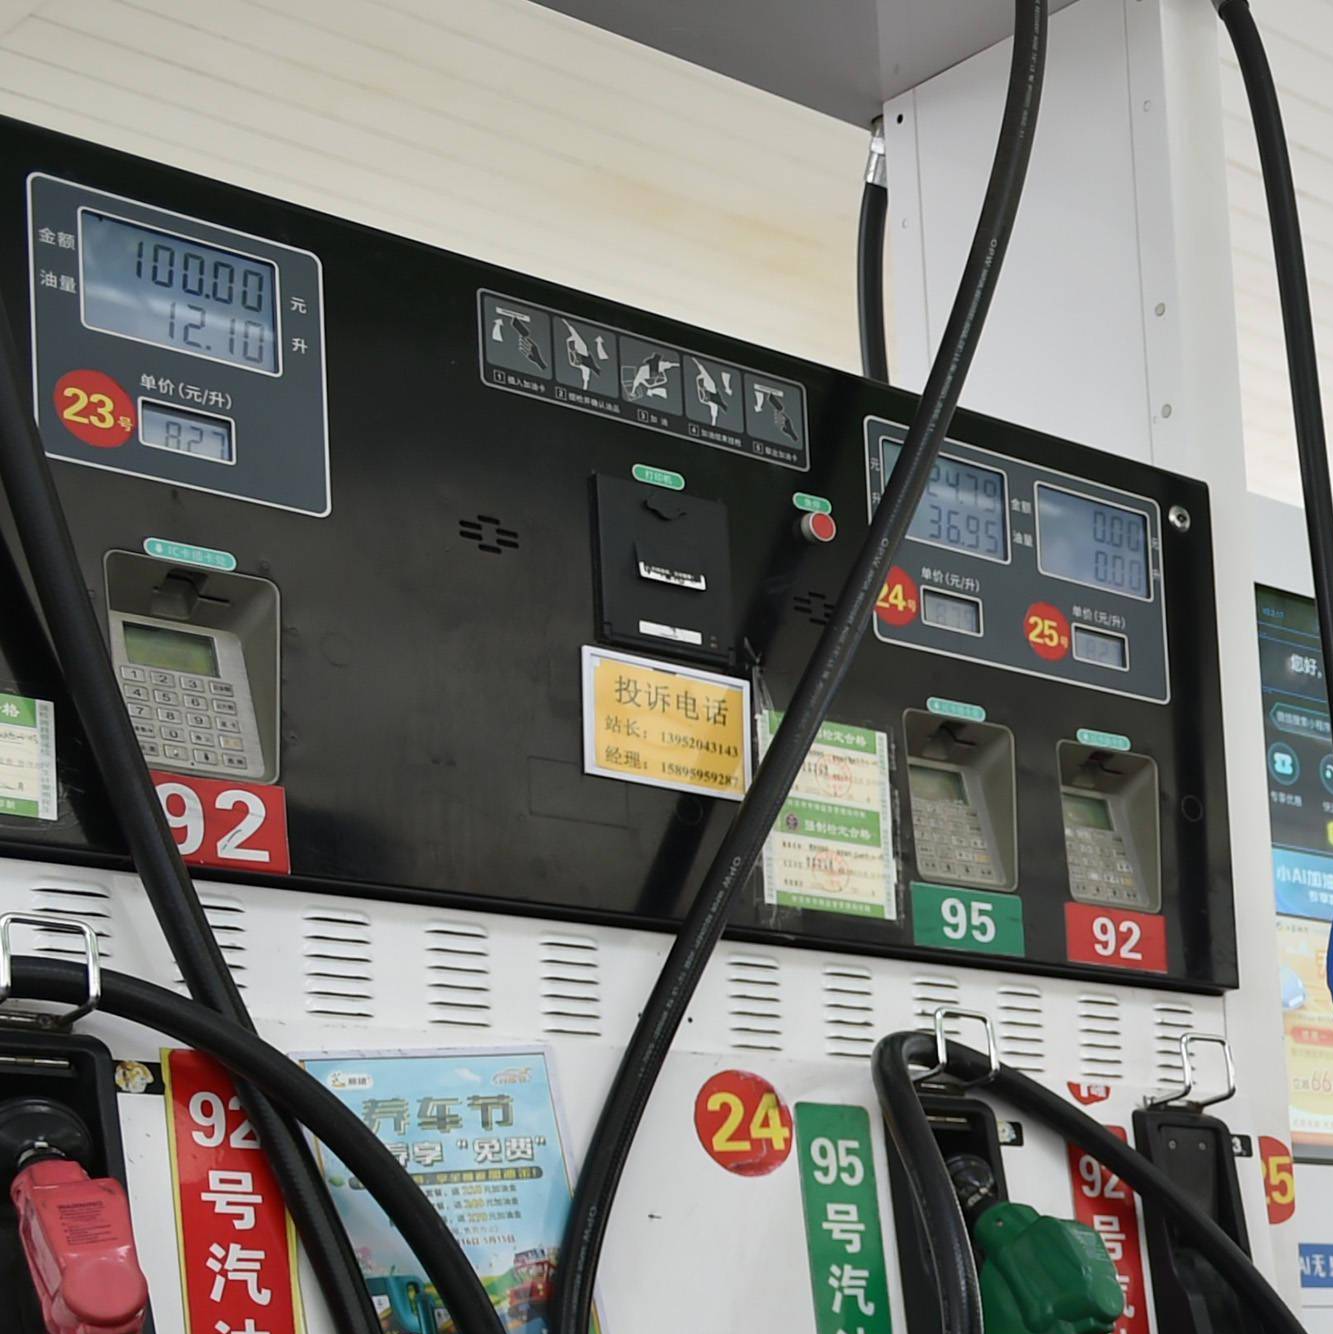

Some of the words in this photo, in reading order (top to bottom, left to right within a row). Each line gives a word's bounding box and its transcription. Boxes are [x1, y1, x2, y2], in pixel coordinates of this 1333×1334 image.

[38, 227, 76, 251] 金额
[39, 269, 77, 294] 油量
[135, 241, 265, 313] 100.00
[290, 296, 307, 314] 元
[168, 302, 265, 365] 12.10
[291, 337, 308, 354] 升
[614, 674, 729, 727] 投诉电话
[155, 781, 271, 863] 92
[940, 897, 996, 944] 95
[1092, 916, 1143, 961] 92
[706, 1091, 791, 1152] 24
[1260, 1155, 1296, 1205] 5
